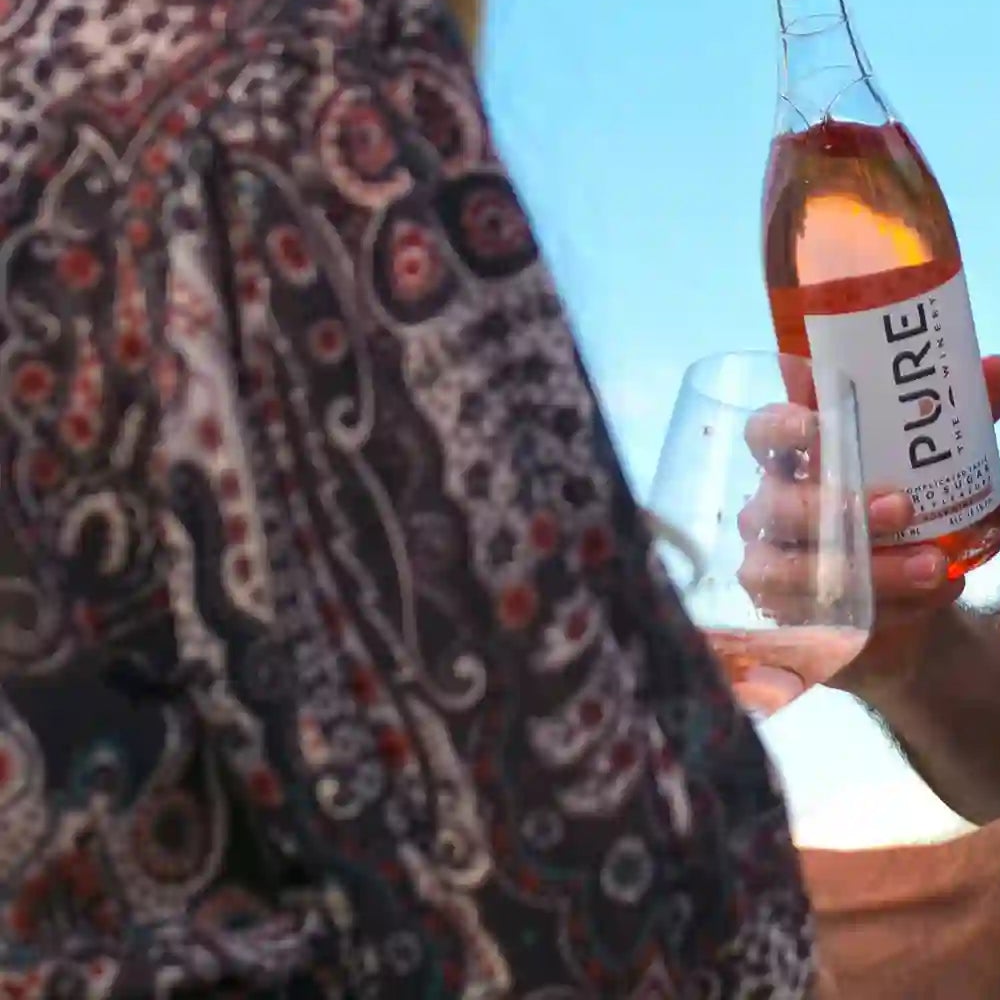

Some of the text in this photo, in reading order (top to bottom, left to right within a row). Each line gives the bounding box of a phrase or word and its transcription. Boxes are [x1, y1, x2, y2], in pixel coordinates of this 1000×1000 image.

[882, 302, 953, 470] PURE
[928, 297, 965, 455] THE WINERY
